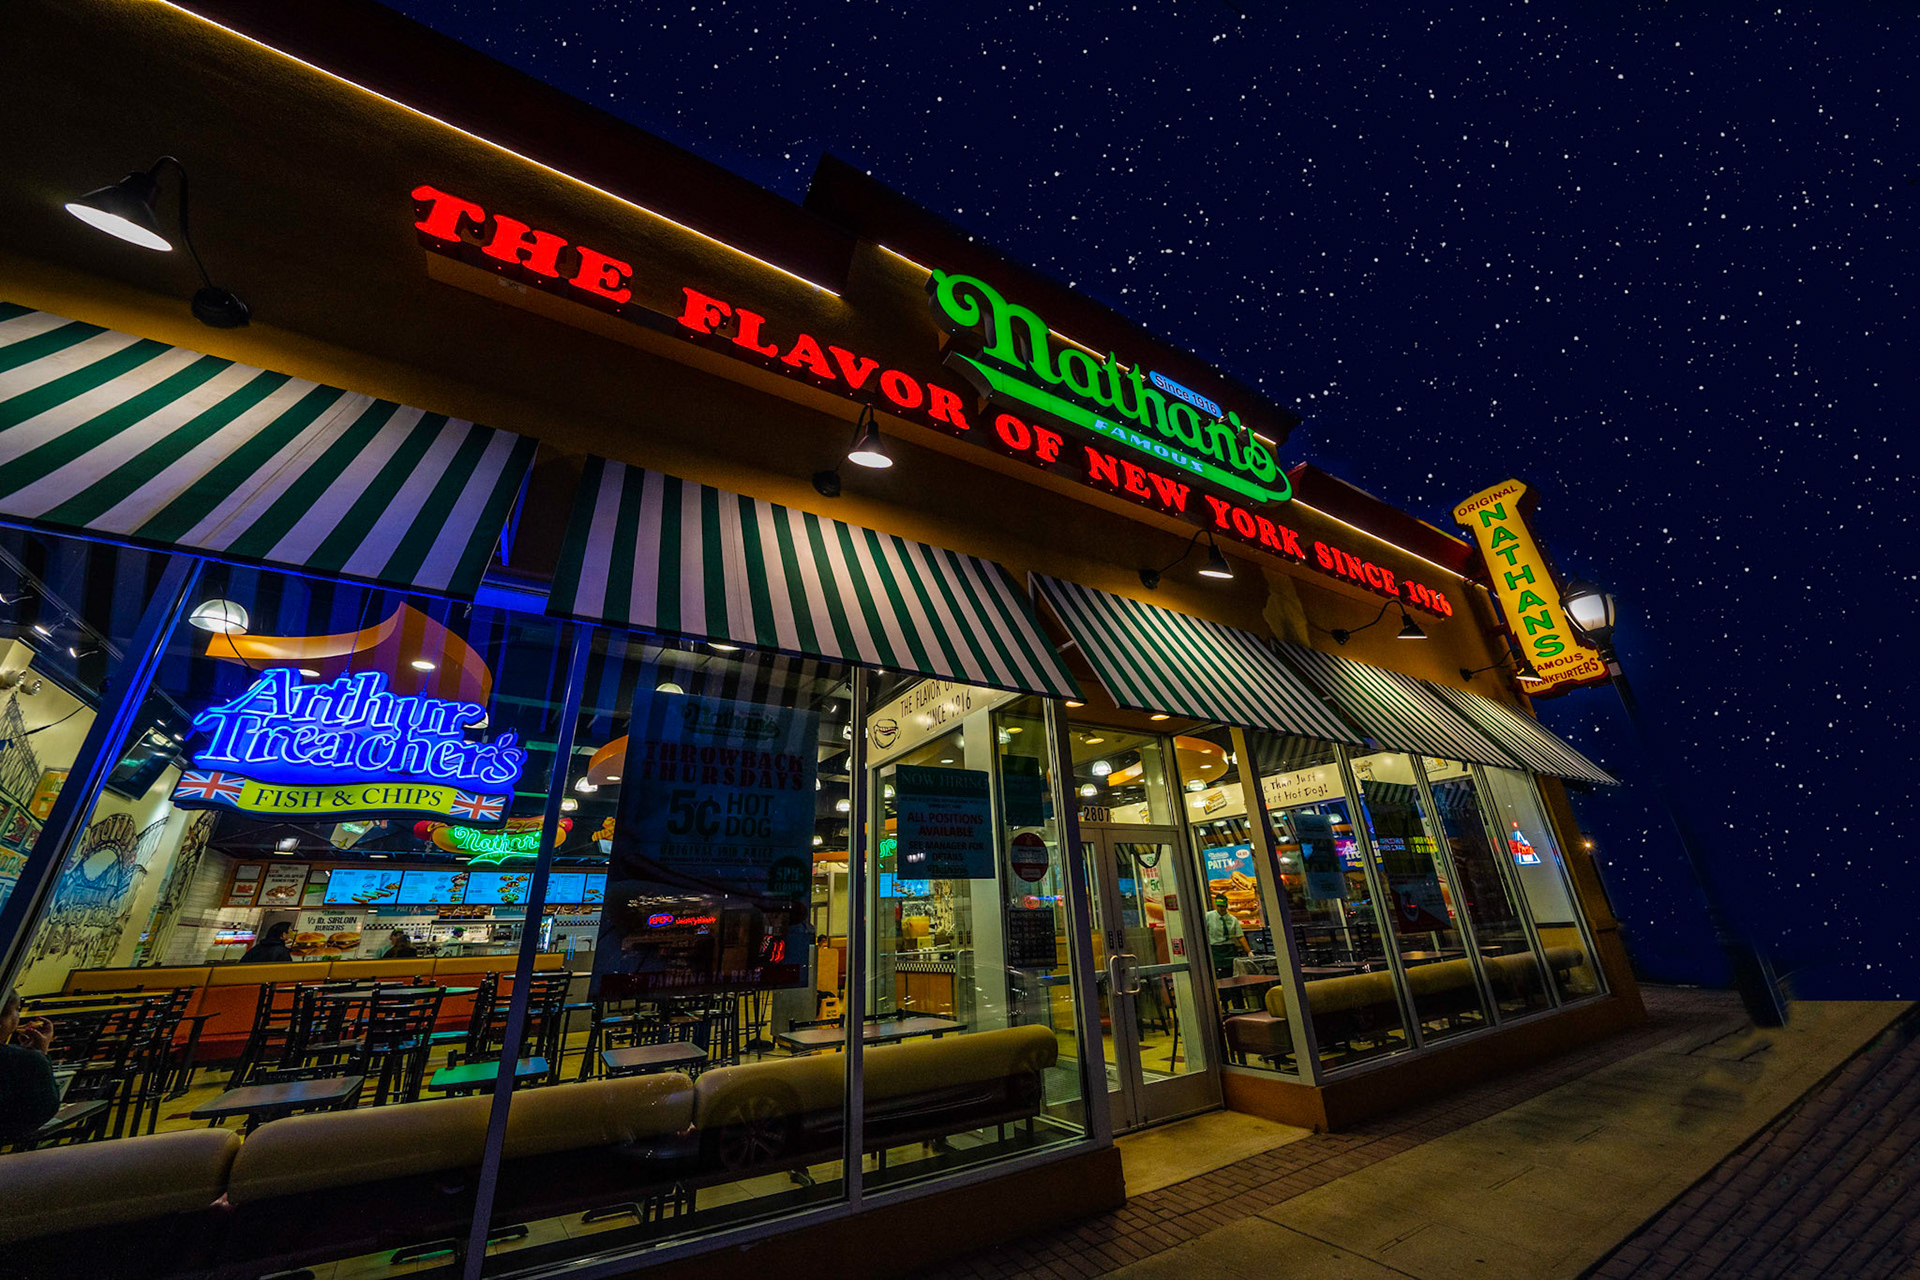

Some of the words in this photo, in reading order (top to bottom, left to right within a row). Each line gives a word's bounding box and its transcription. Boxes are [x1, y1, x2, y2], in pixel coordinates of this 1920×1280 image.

[411, 185, 634, 304] THE
[677, 287, 970, 431] FLAVOR
[995, 414, 1063, 463] OF
[1084, 446, 1190, 513] NEW
[1204, 494, 1305, 564] YORK
[1313, 540, 1400, 598] SINCE
[1404, 579, 1454, 618] 1916
[1155, 375, 1190, 400] Since
[1192, 394, 1218, 415] 1916
[1094, 418, 1203, 473] FAMOUS
[1458, 485, 1518, 517] ORIGINAL
[1478, 502, 1565, 658] NATHANS
[1524, 657, 1599, 689] FRANKFURTERS
[1533, 653, 1584, 671] AMOUS
[196, 667, 486, 736] Arthur
[901, 695, 912, 718] THE
[916, 680, 941, 710] FLAVOR
[926, 703, 946, 731] SINCE
[952, 689, 971, 717] 1916
[193, 713, 522, 783] Treacher's
[645, 740, 804, 773] THROWBACK
[642, 759, 803, 791] THURSDAYS
[900, 771, 937, 787] NOW
[940, 775, 988, 790] HIRING
[1271, 780, 1292, 791] Than
[1296, 773, 1316, 786] Just
[253, 788, 324, 808] FISH
[332, 789, 355, 807] &
[362, 788, 443, 808] CHIPS
[726, 792, 774, 817] HOT
[1265, 795, 1281, 804] est
[1284, 789, 1302, 800] Hot
[1305, 784, 1328, 797] Dog!
[667, 789, 721, 842] 5¢
[907, 811, 926, 823] ALL
[929, 812, 984, 825] POSITIONS
[1083, 806, 1111, 823] 2807
[454, 826, 541, 852] Nathan'
[725, 817, 771, 839] DOG
[919, 826, 975, 838] AVAILABLE
[909, 840, 924, 850] SEE
[1207, 857, 1233, 871] PATTY
[314, 924, 345, 932] BURGERS
[327, 916, 358, 924] SIRLOIN
